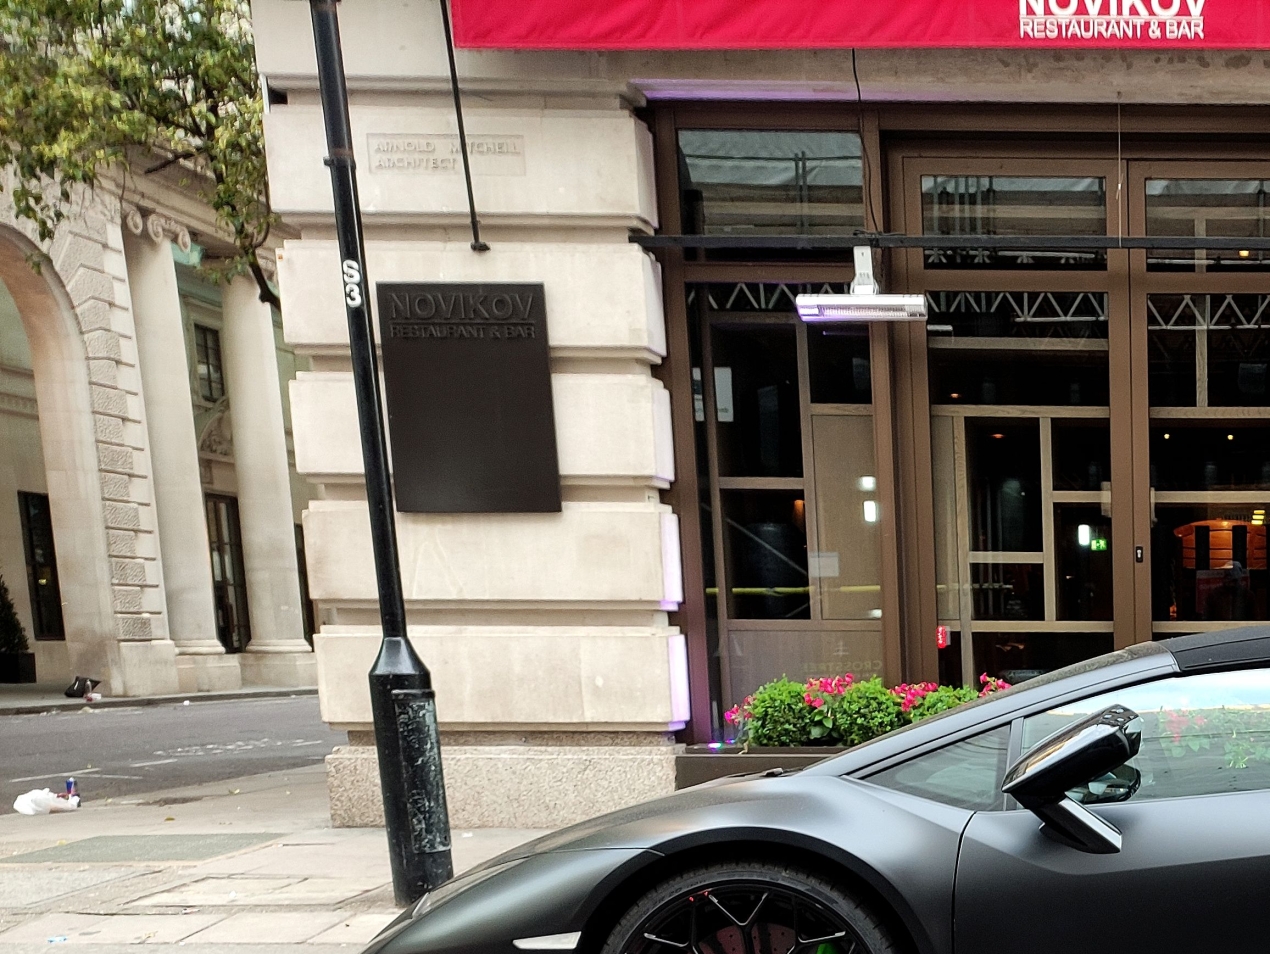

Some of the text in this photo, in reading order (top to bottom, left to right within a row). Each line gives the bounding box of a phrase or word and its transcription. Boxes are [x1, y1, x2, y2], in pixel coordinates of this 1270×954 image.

[1019, 18, 1205, 40] RESTAURANT & BAR
[375, 141, 521, 155] ARNOLD MTCHELL
[375, 157, 458, 170] ARCHITECT
[389, 290, 535, 320] NOVIKOV
[390, 323, 536, 338] RESTAURANT & BAR
